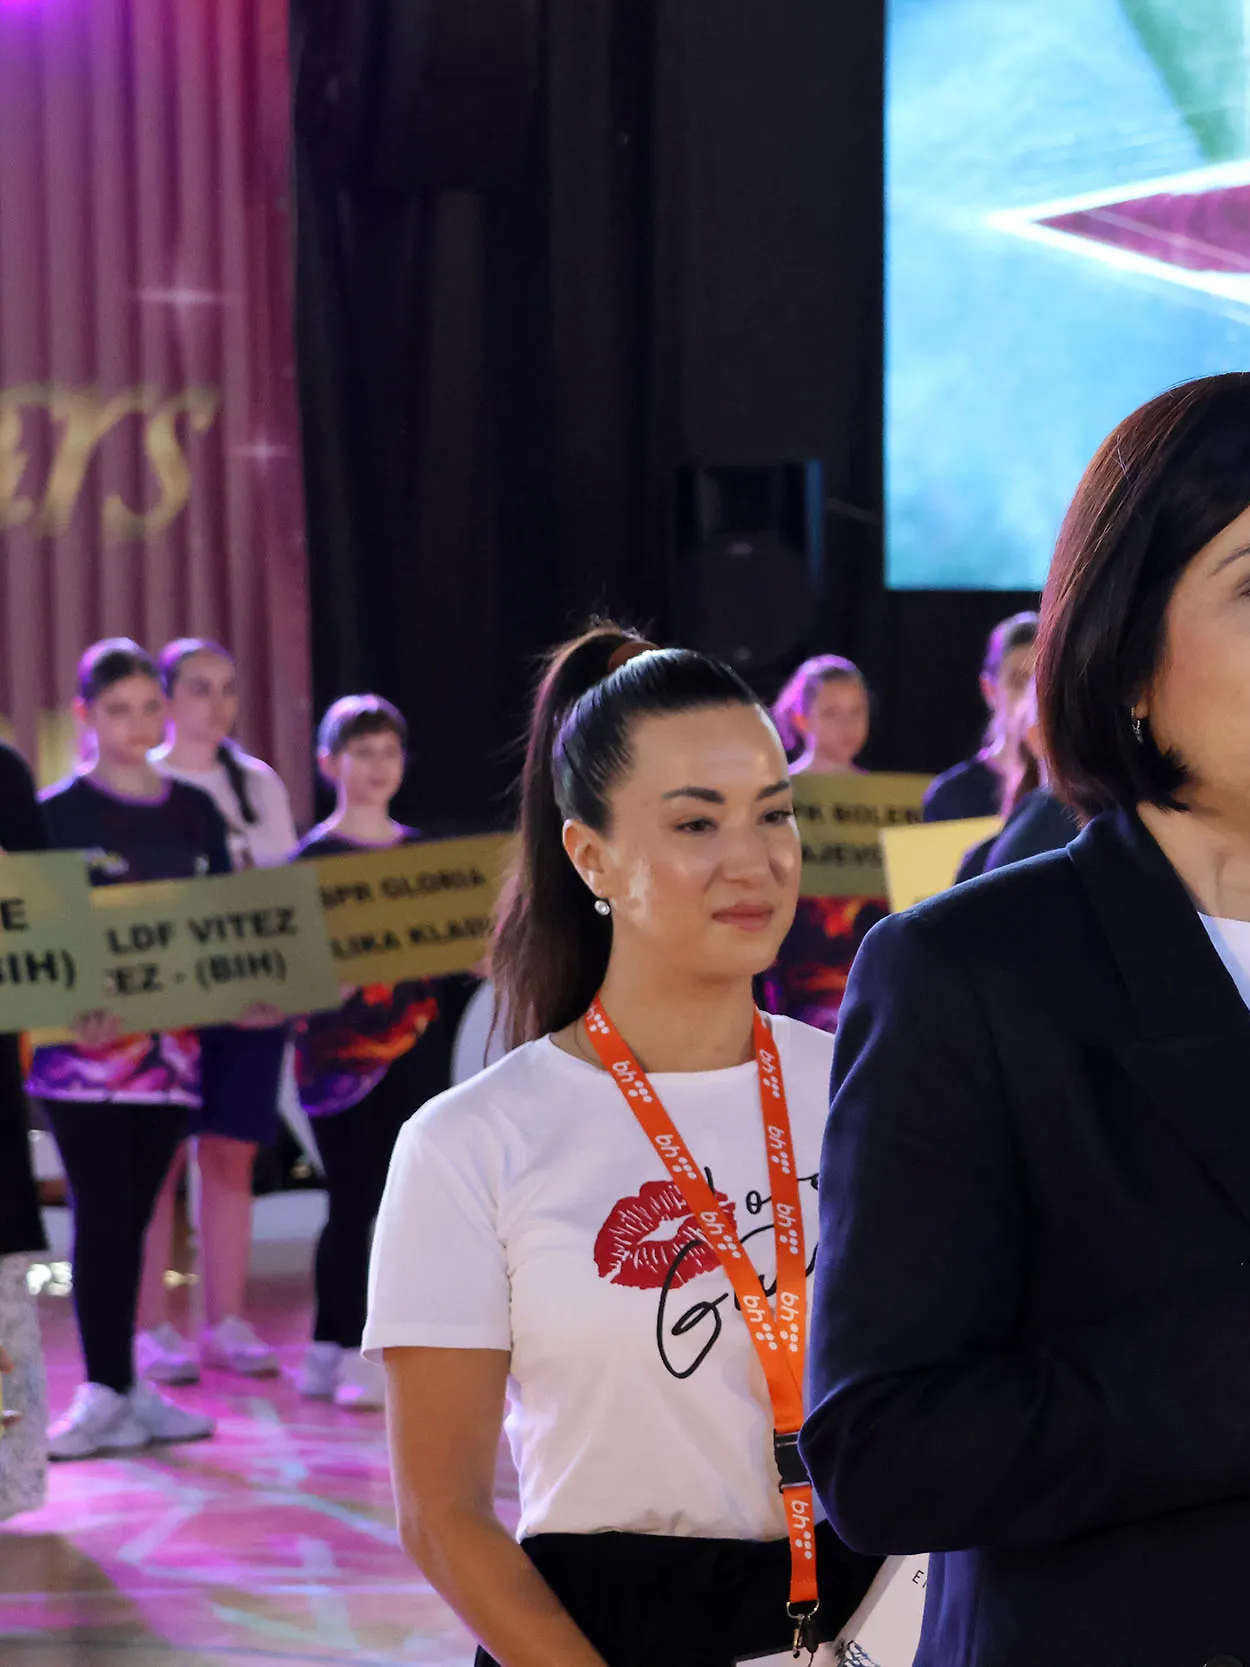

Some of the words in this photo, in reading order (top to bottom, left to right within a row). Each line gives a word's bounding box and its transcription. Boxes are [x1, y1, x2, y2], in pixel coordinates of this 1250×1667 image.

[187, 906, 299, 944] VITEZ
[0, 948, 76, 991] IH)
[105, 962, 165, 995] EZ
